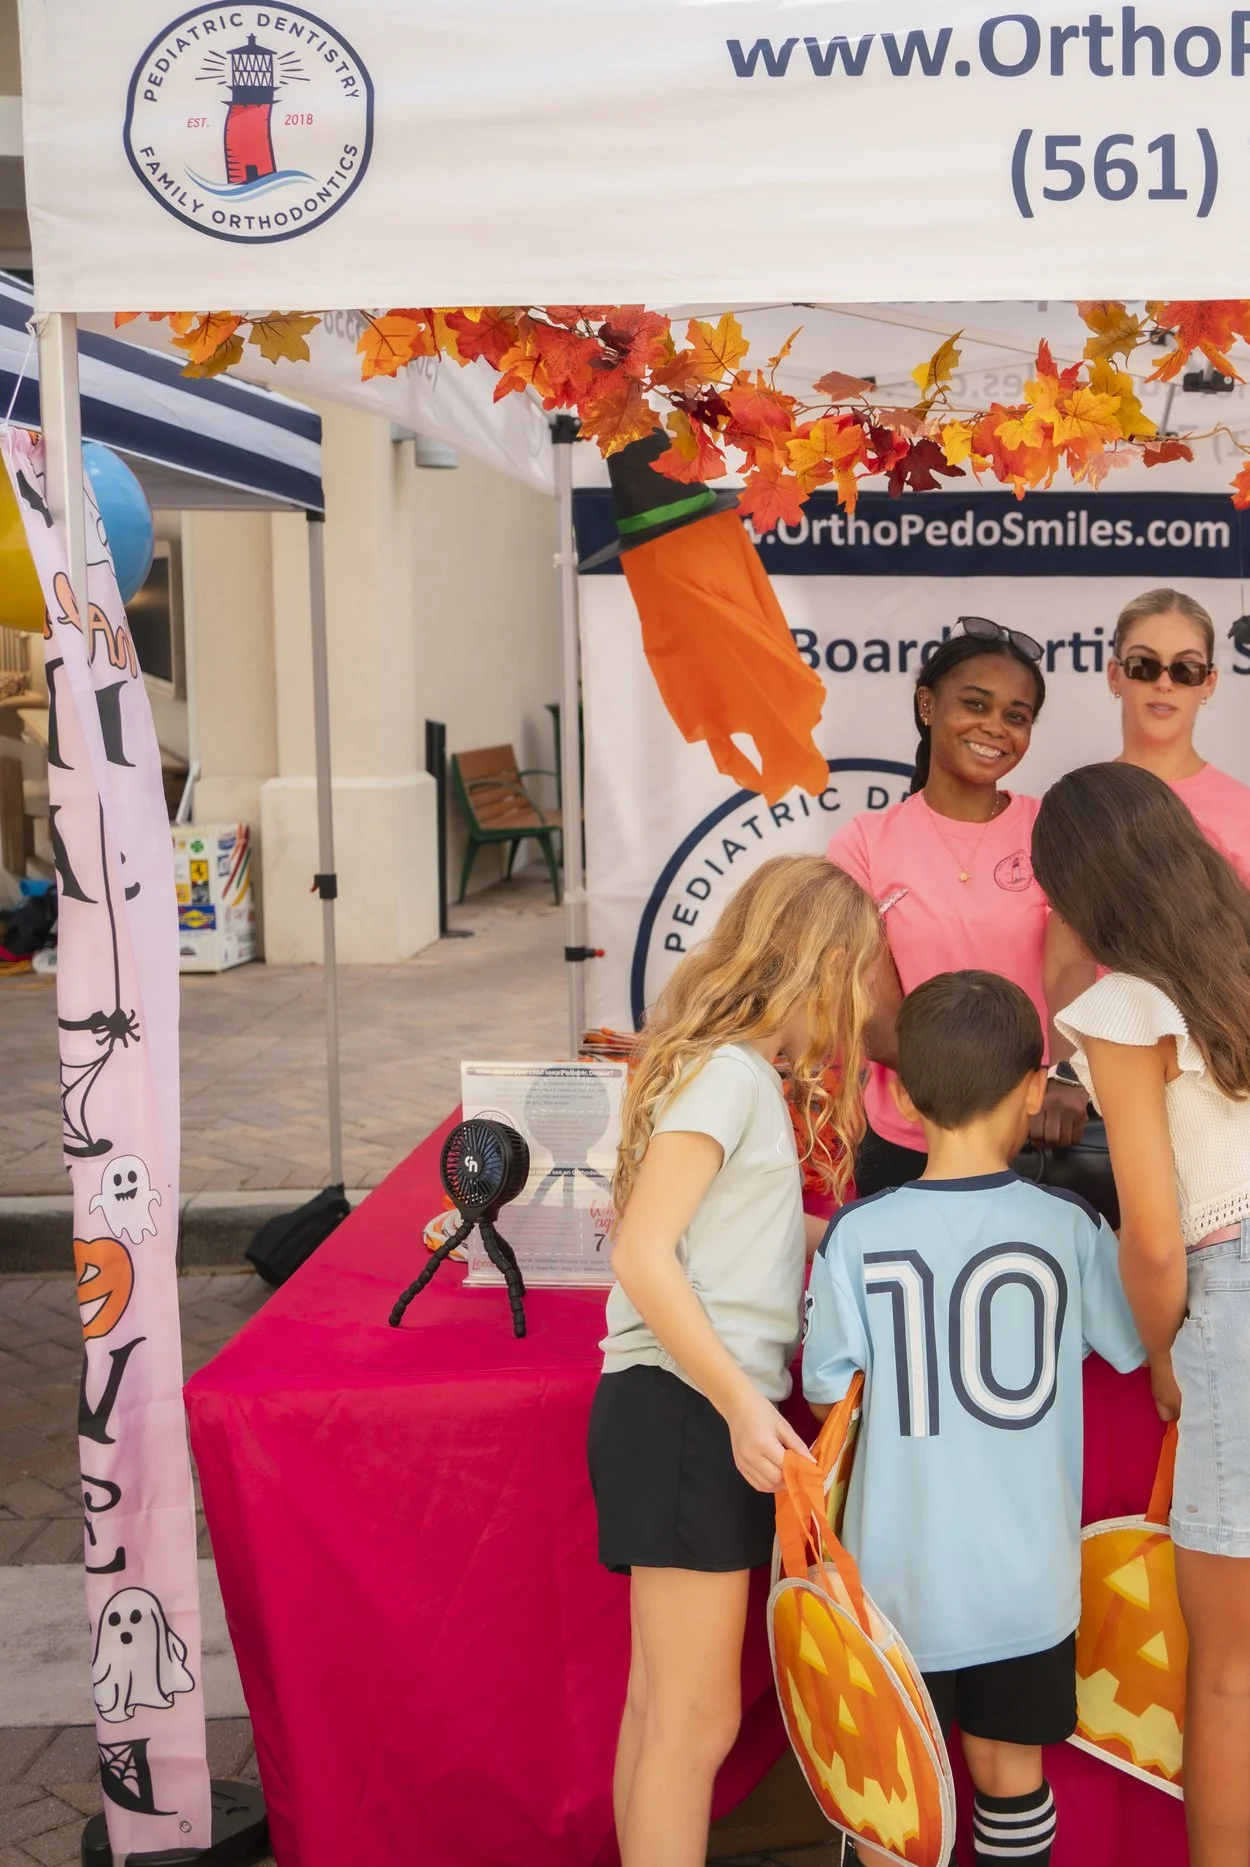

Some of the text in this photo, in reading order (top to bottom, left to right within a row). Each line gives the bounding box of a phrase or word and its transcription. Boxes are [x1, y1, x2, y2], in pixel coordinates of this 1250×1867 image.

[144, 12, 360, 102] PEDIATRIC DENTISTRY
[186, 114, 314, 128] EST. 2018
[140, 144, 358, 230] FAMILY ORTHODONTICS
[1011, 128, 1219, 218] (561)
[744, 508, 1230, 549] .OrthoPedoSmiles.com
[664, 787, 841, 953] PEDIATRIC
[862, 1241, 1068, 1437] 10
